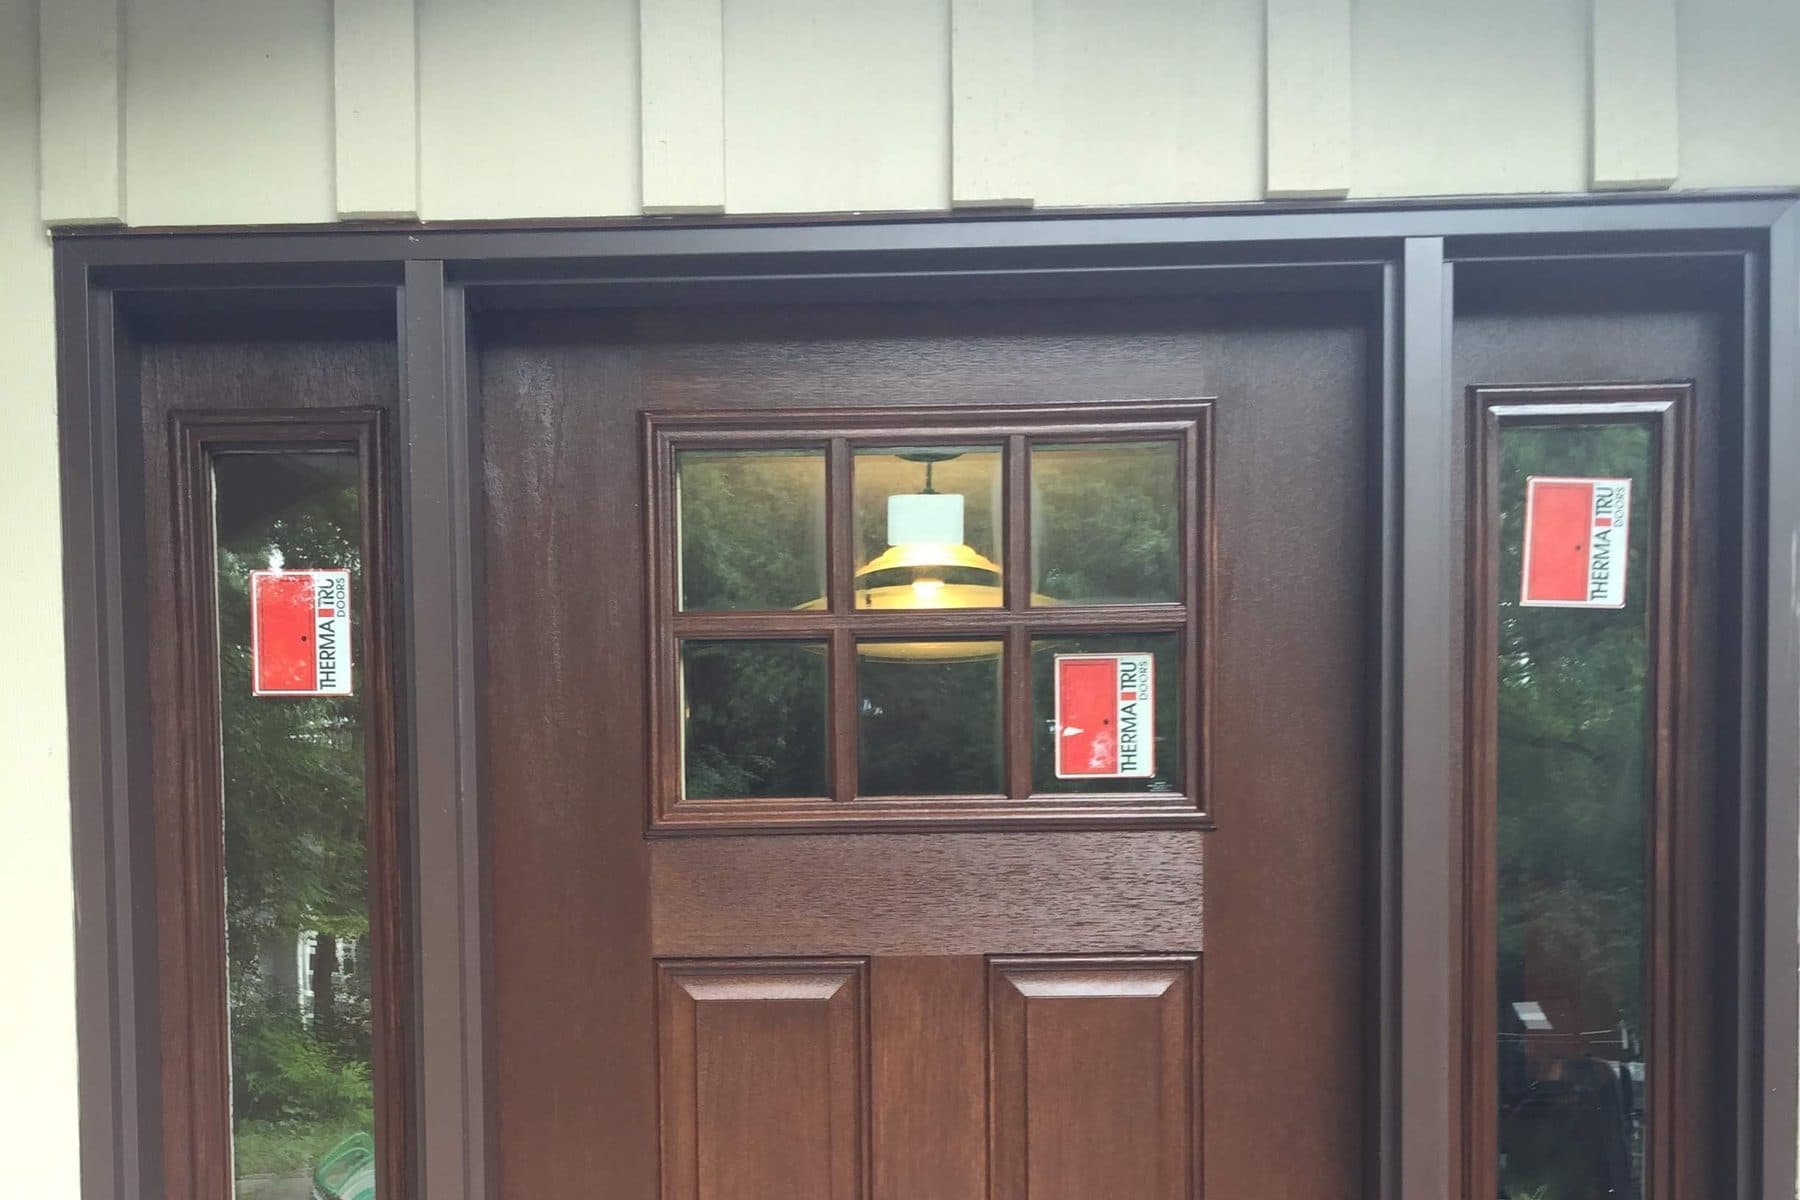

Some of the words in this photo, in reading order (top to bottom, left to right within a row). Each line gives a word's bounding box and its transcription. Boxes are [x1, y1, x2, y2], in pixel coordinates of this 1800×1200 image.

[1596, 487, 1613, 515] TRU
[1591, 529, 1612, 600] THERMA
[318, 579, 334, 607] TRU
[336, 578, 345, 617] DOORS
[319, 620, 336, 690] THERMA
[1121, 662, 1136, 690] TRU
[1121, 703, 1136, 772] THERMA
